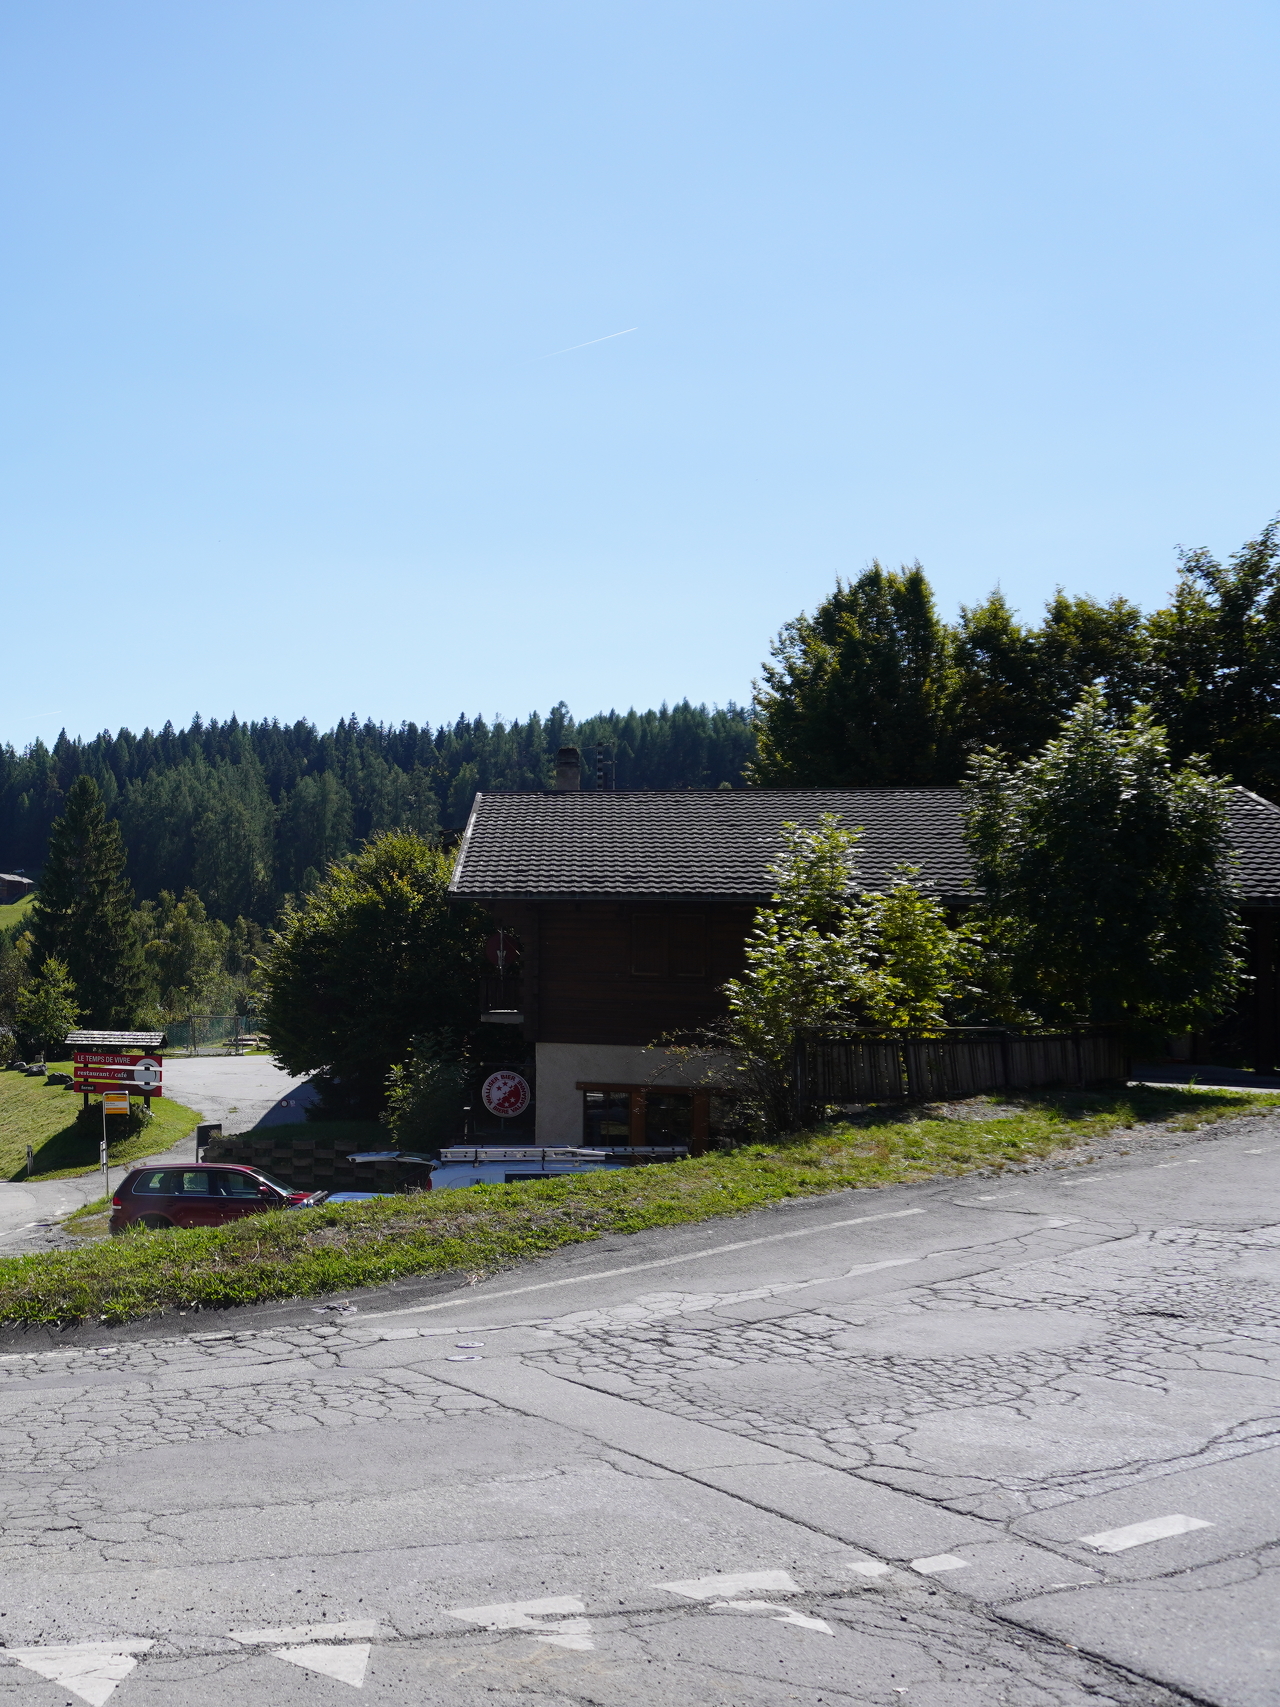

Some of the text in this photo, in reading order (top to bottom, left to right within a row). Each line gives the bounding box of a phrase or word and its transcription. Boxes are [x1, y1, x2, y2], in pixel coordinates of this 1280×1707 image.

[86, 1055, 105, 1063] TEMPS
[485, 1076, 500, 1106] WALLISER
[510, 1080, 527, 1113] VALAISANNE
